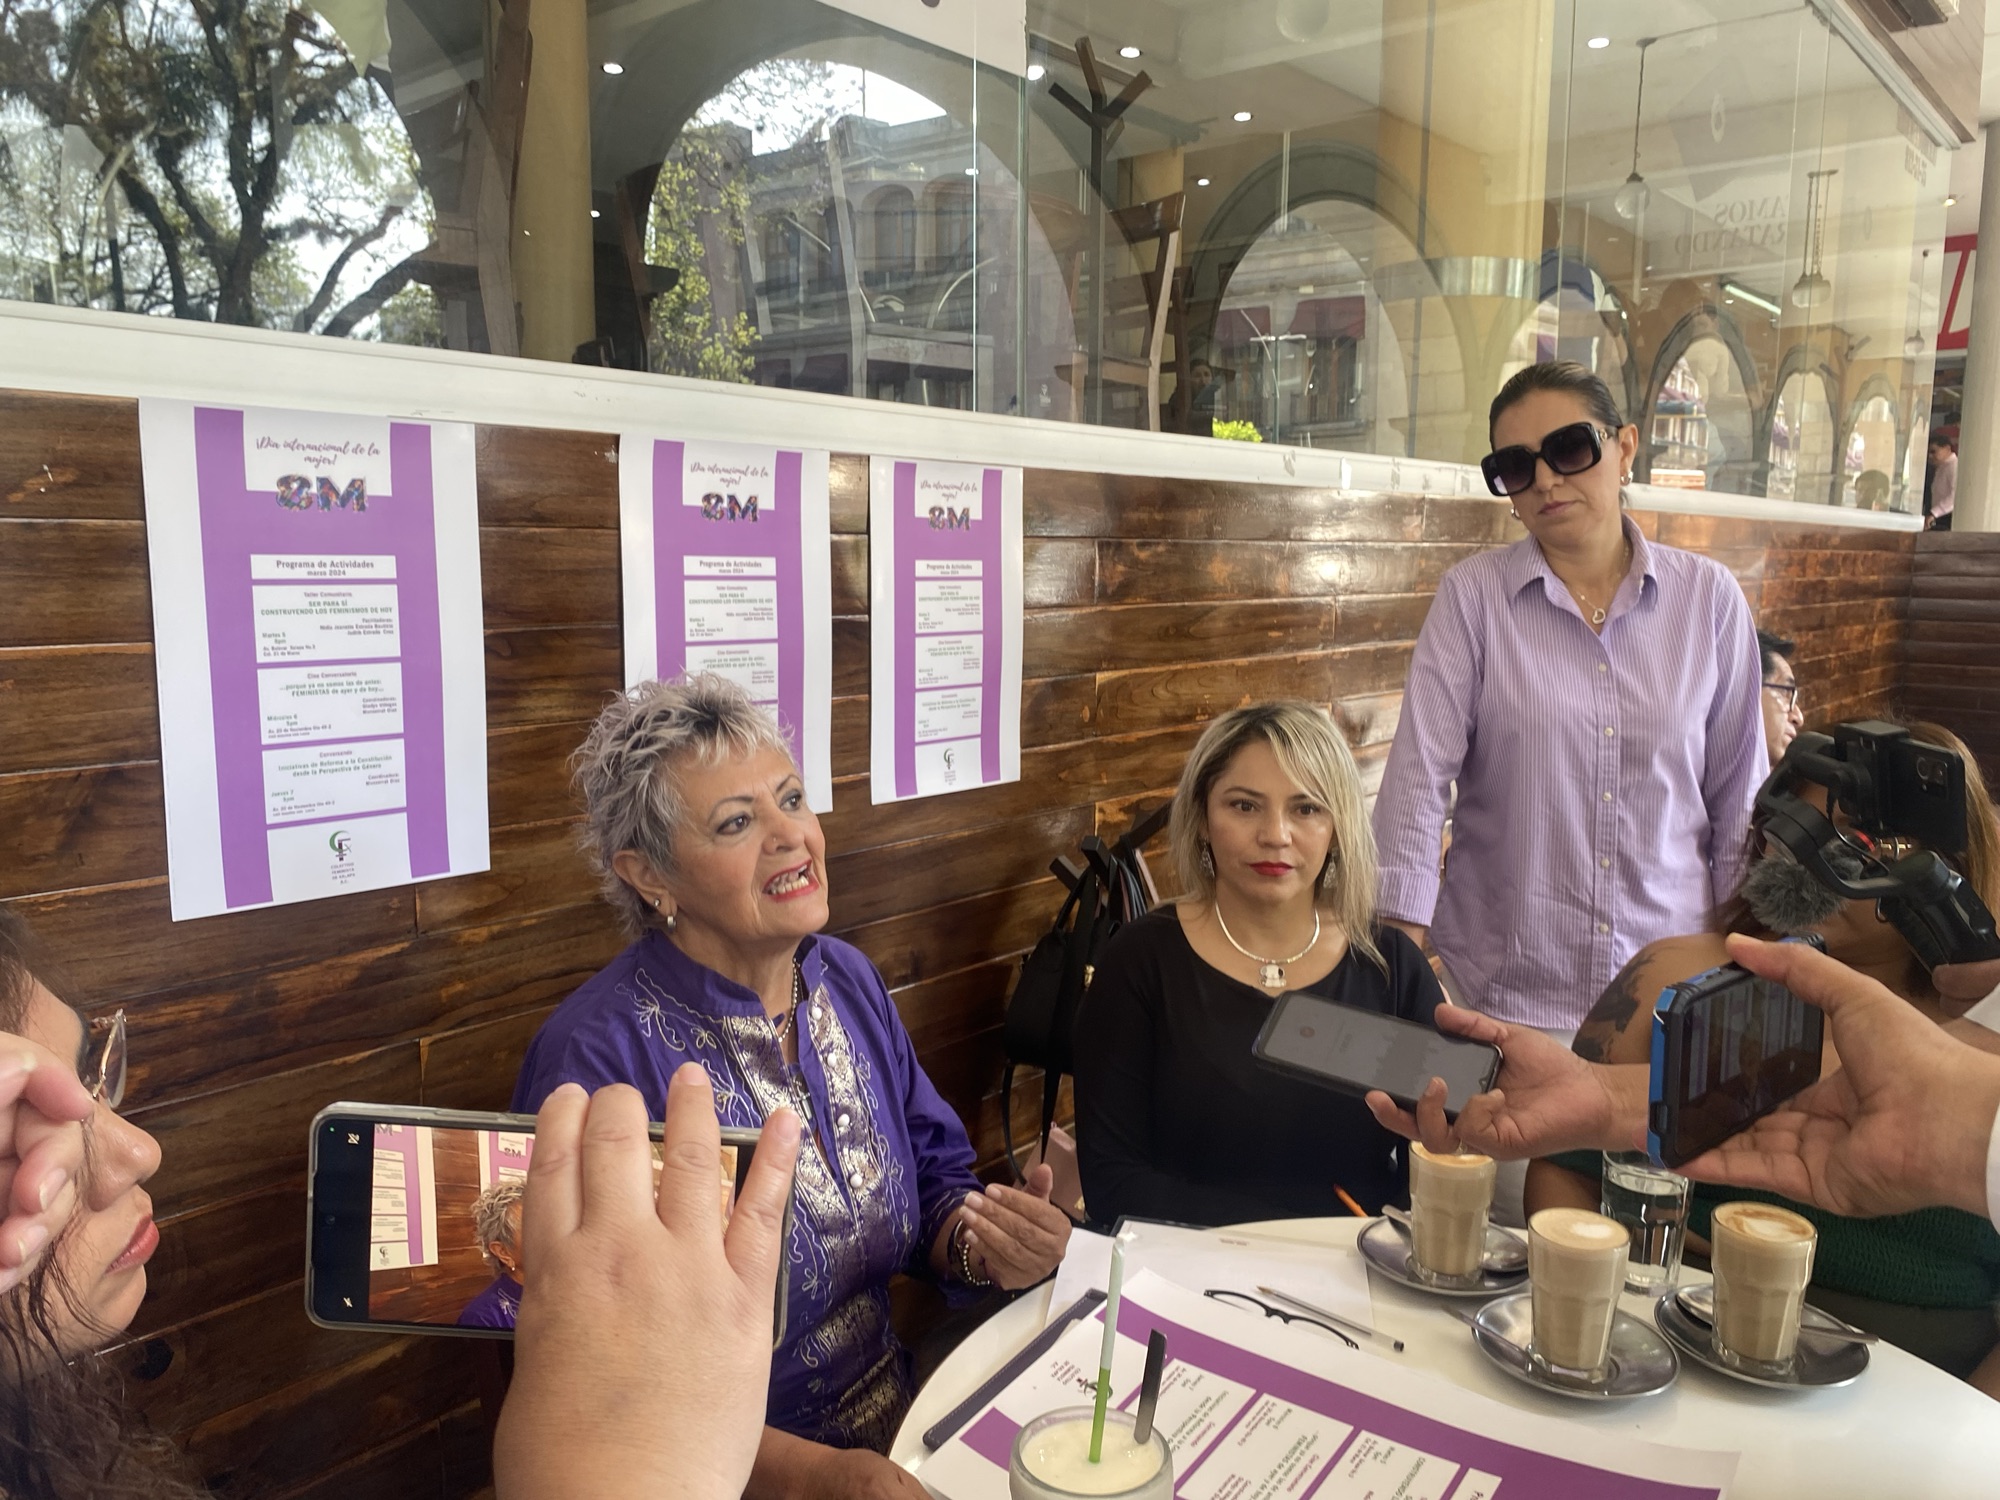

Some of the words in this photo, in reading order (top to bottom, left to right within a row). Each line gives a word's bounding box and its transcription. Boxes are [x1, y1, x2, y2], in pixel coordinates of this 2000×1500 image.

[283, 438, 350, 455] internacional
[352, 443, 365, 455] de
[367, 442, 380, 456] la
[304, 454, 337, 468] mujer!
[276, 474, 368, 512] 8M
[701, 492, 760, 523] 8M
[928, 505, 971, 532] 8M
[276, 560, 315, 569] Programa
[330, 560, 374, 568] Actividades
[358, 755, 392, 763] Constitución
[319, 766, 352, 775] Perspectiva
